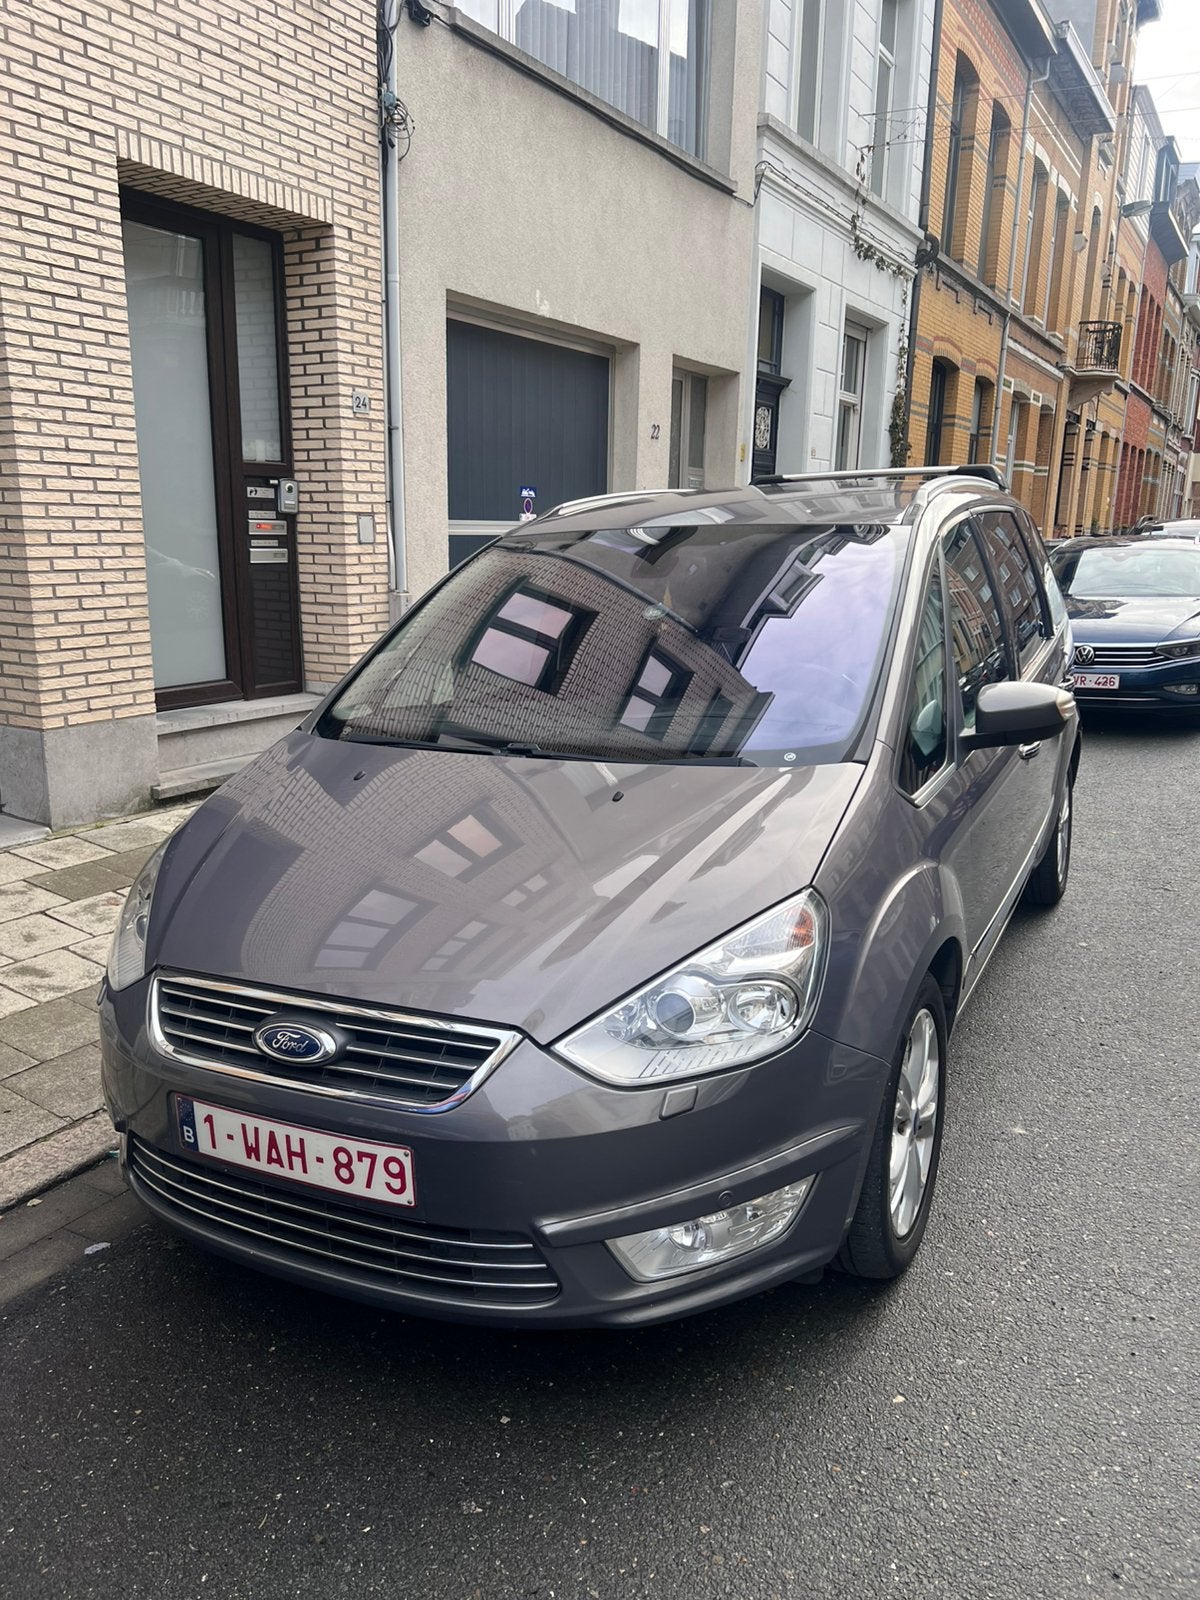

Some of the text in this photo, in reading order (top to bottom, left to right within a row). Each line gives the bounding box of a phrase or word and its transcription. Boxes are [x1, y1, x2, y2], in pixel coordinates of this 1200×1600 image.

[355, 396, 367, 409] 24
[650, 423, 660, 440] 22
[272, 1031, 309, 1053] Ford
[183, 1125, 195, 1143] B
[203, 1113, 407, 1195] 1-WAH-879
